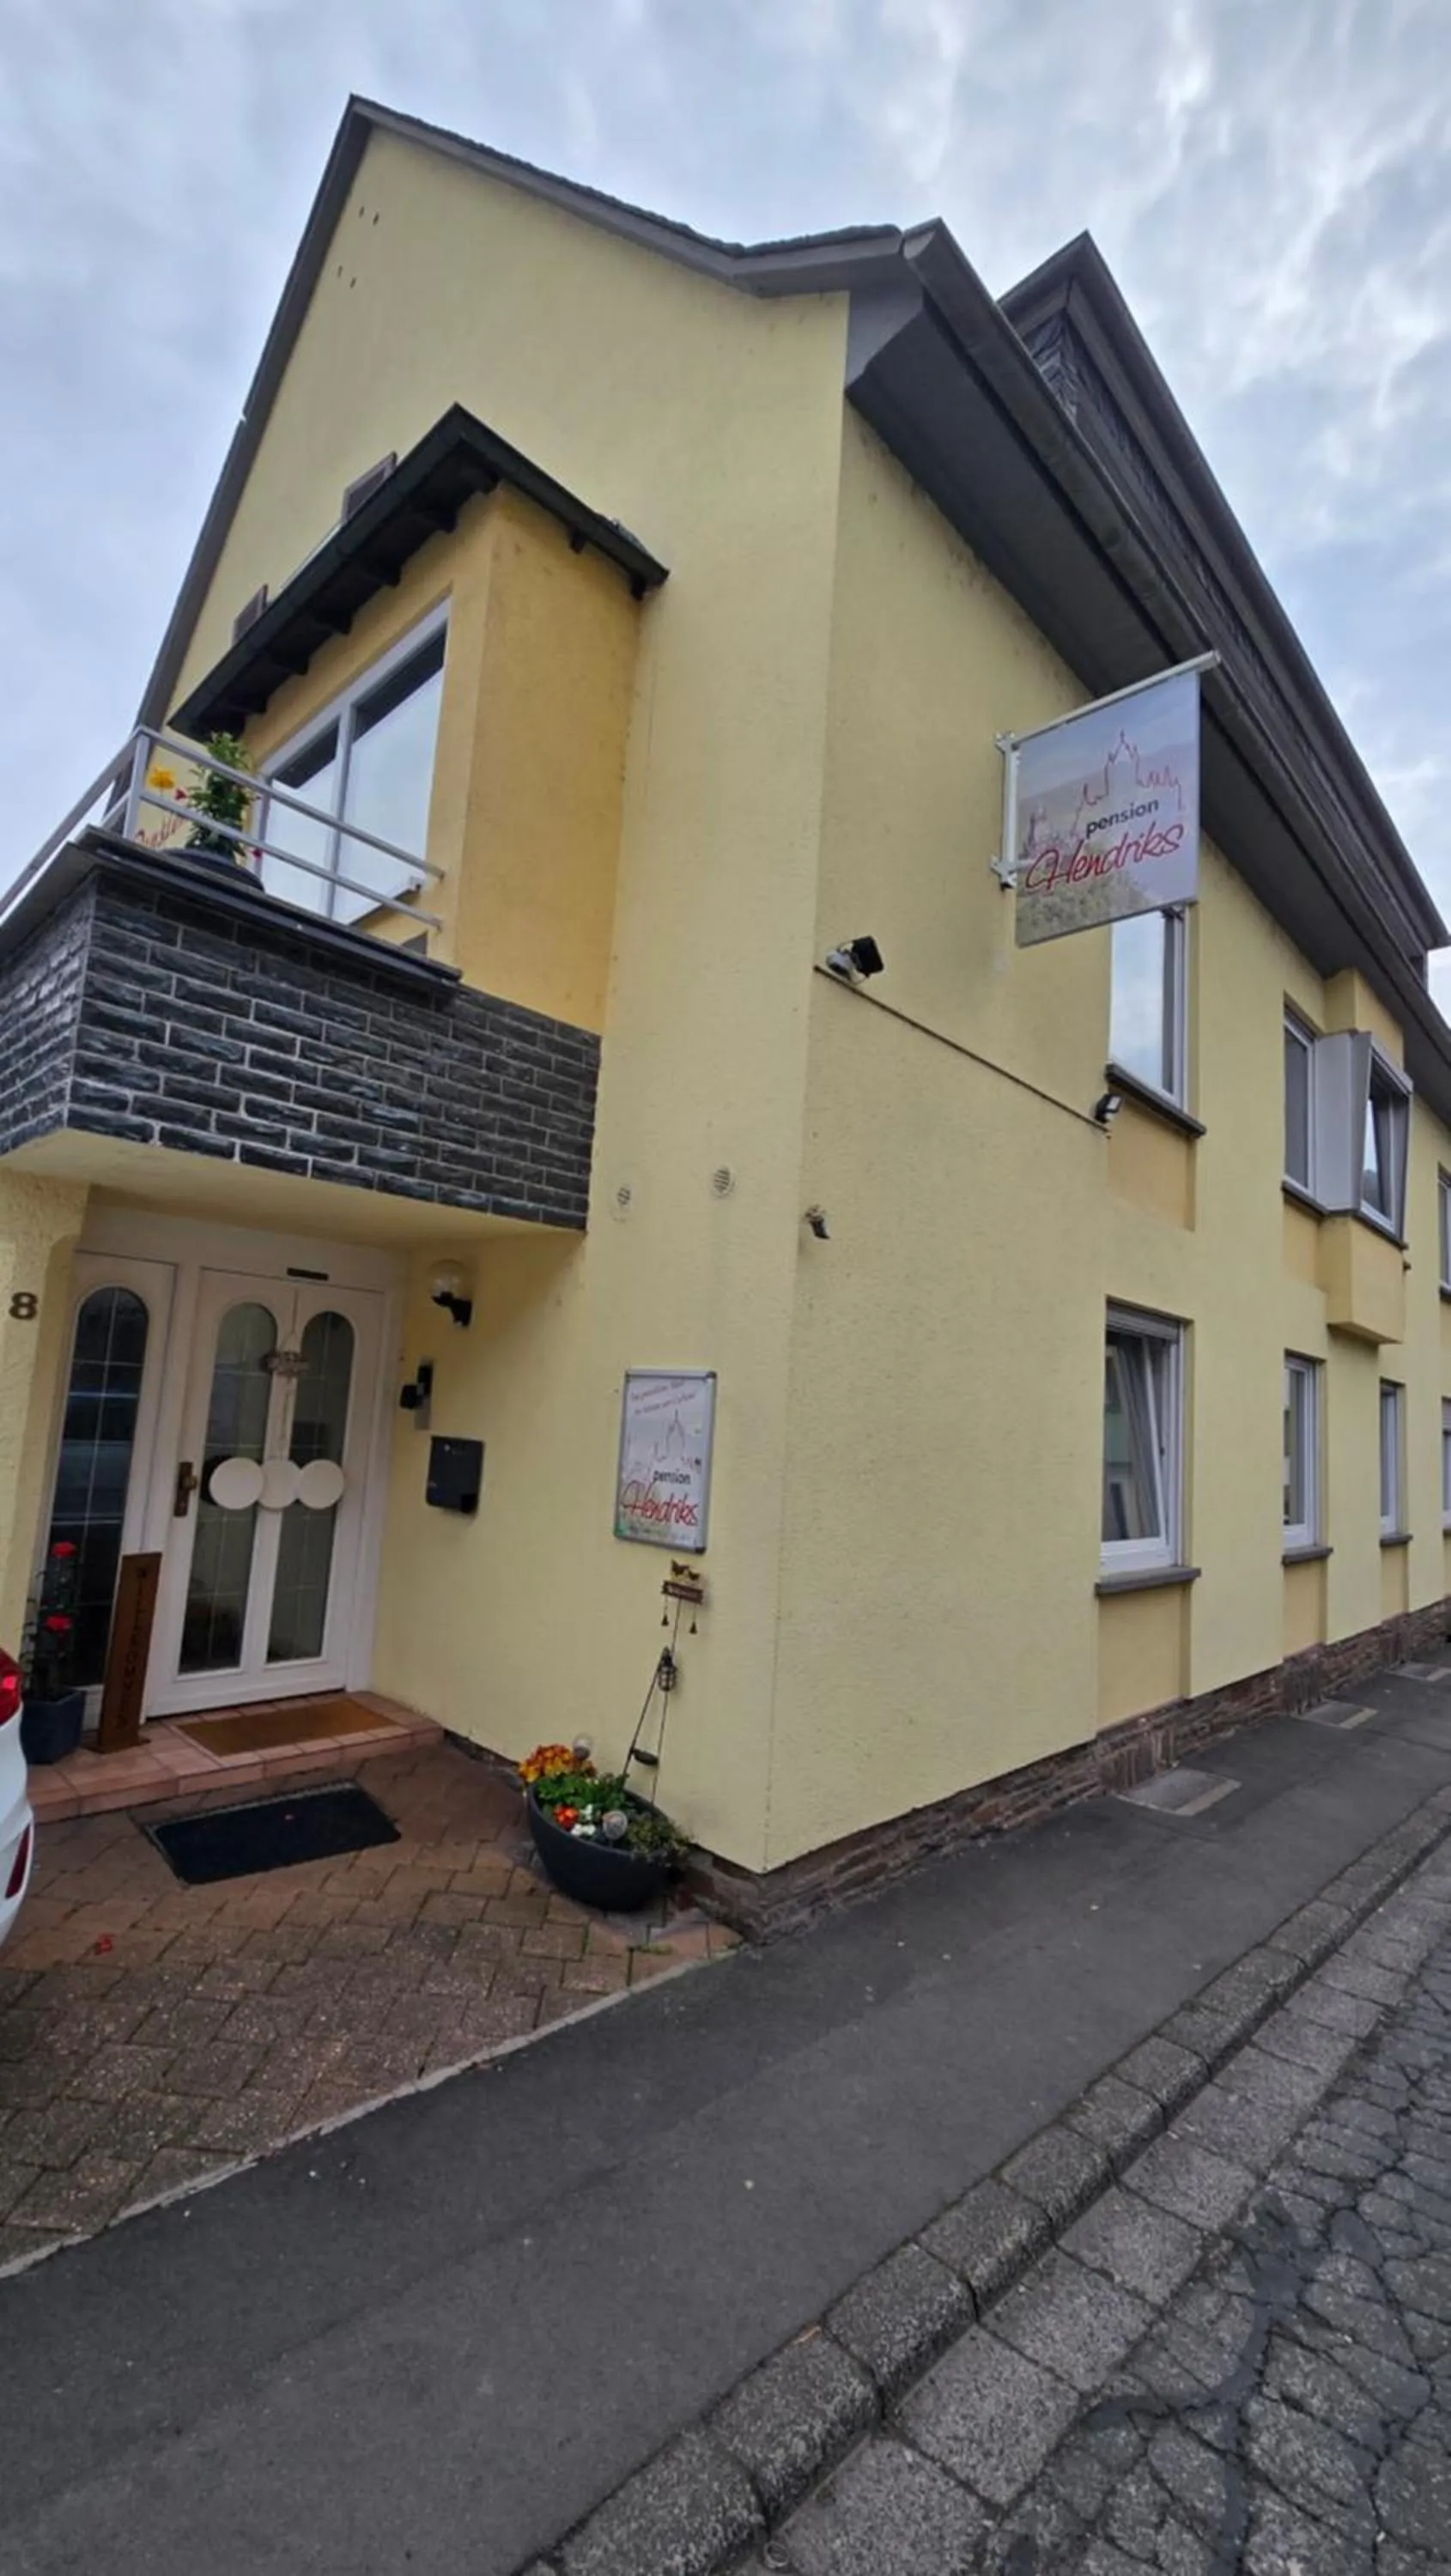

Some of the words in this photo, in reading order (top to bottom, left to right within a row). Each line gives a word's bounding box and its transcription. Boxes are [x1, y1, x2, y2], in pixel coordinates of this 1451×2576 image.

[1085, 799, 1159, 840] pension
[1025, 822, 1185, 893] Hendriks
[9, 1291, 39, 1321] 8
[653, 1467, 691, 1485] pension
[620, 1479, 700, 1526] Hendriks
